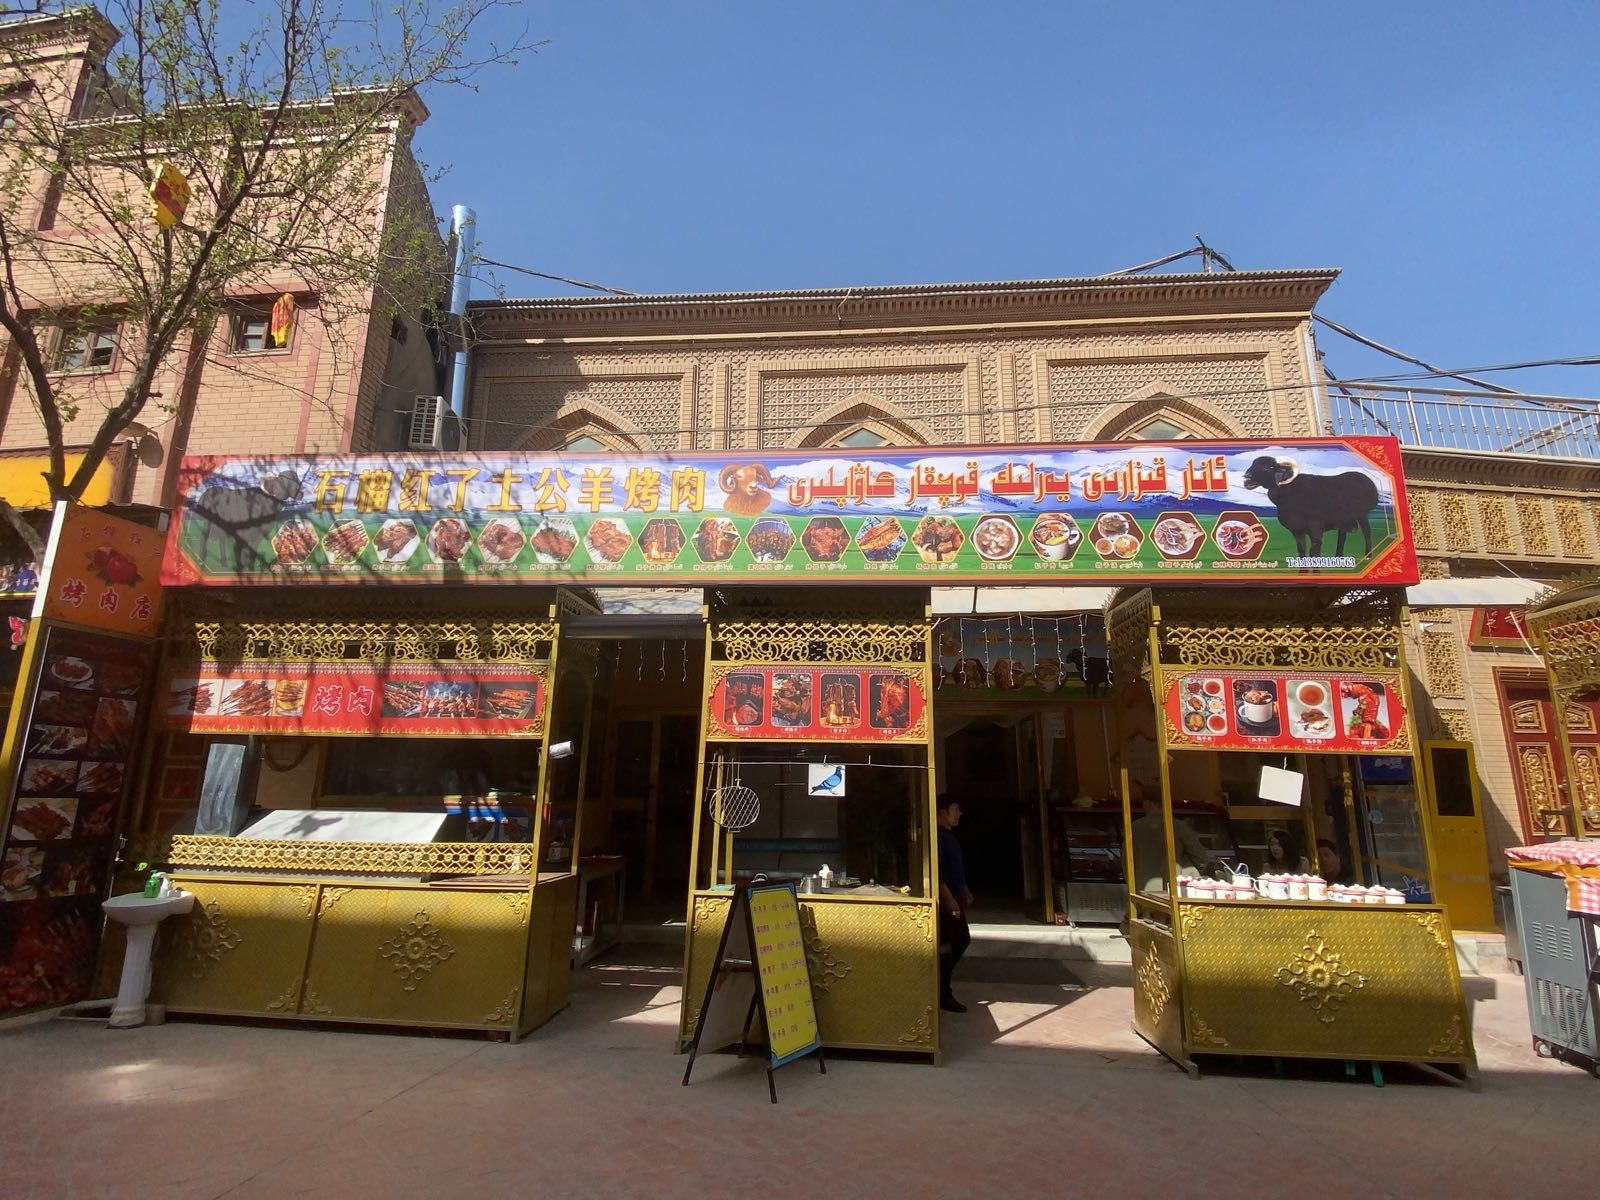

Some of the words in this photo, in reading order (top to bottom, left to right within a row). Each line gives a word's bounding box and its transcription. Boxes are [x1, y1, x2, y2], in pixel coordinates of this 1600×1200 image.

[315, 464, 707, 514] 石榴红了土公羊烤肉
[1178, 455, 1229, 500] ئانار
[60, 579, 153, 620] 烤肉店
[312, 684, 375, 717] 烤肉
